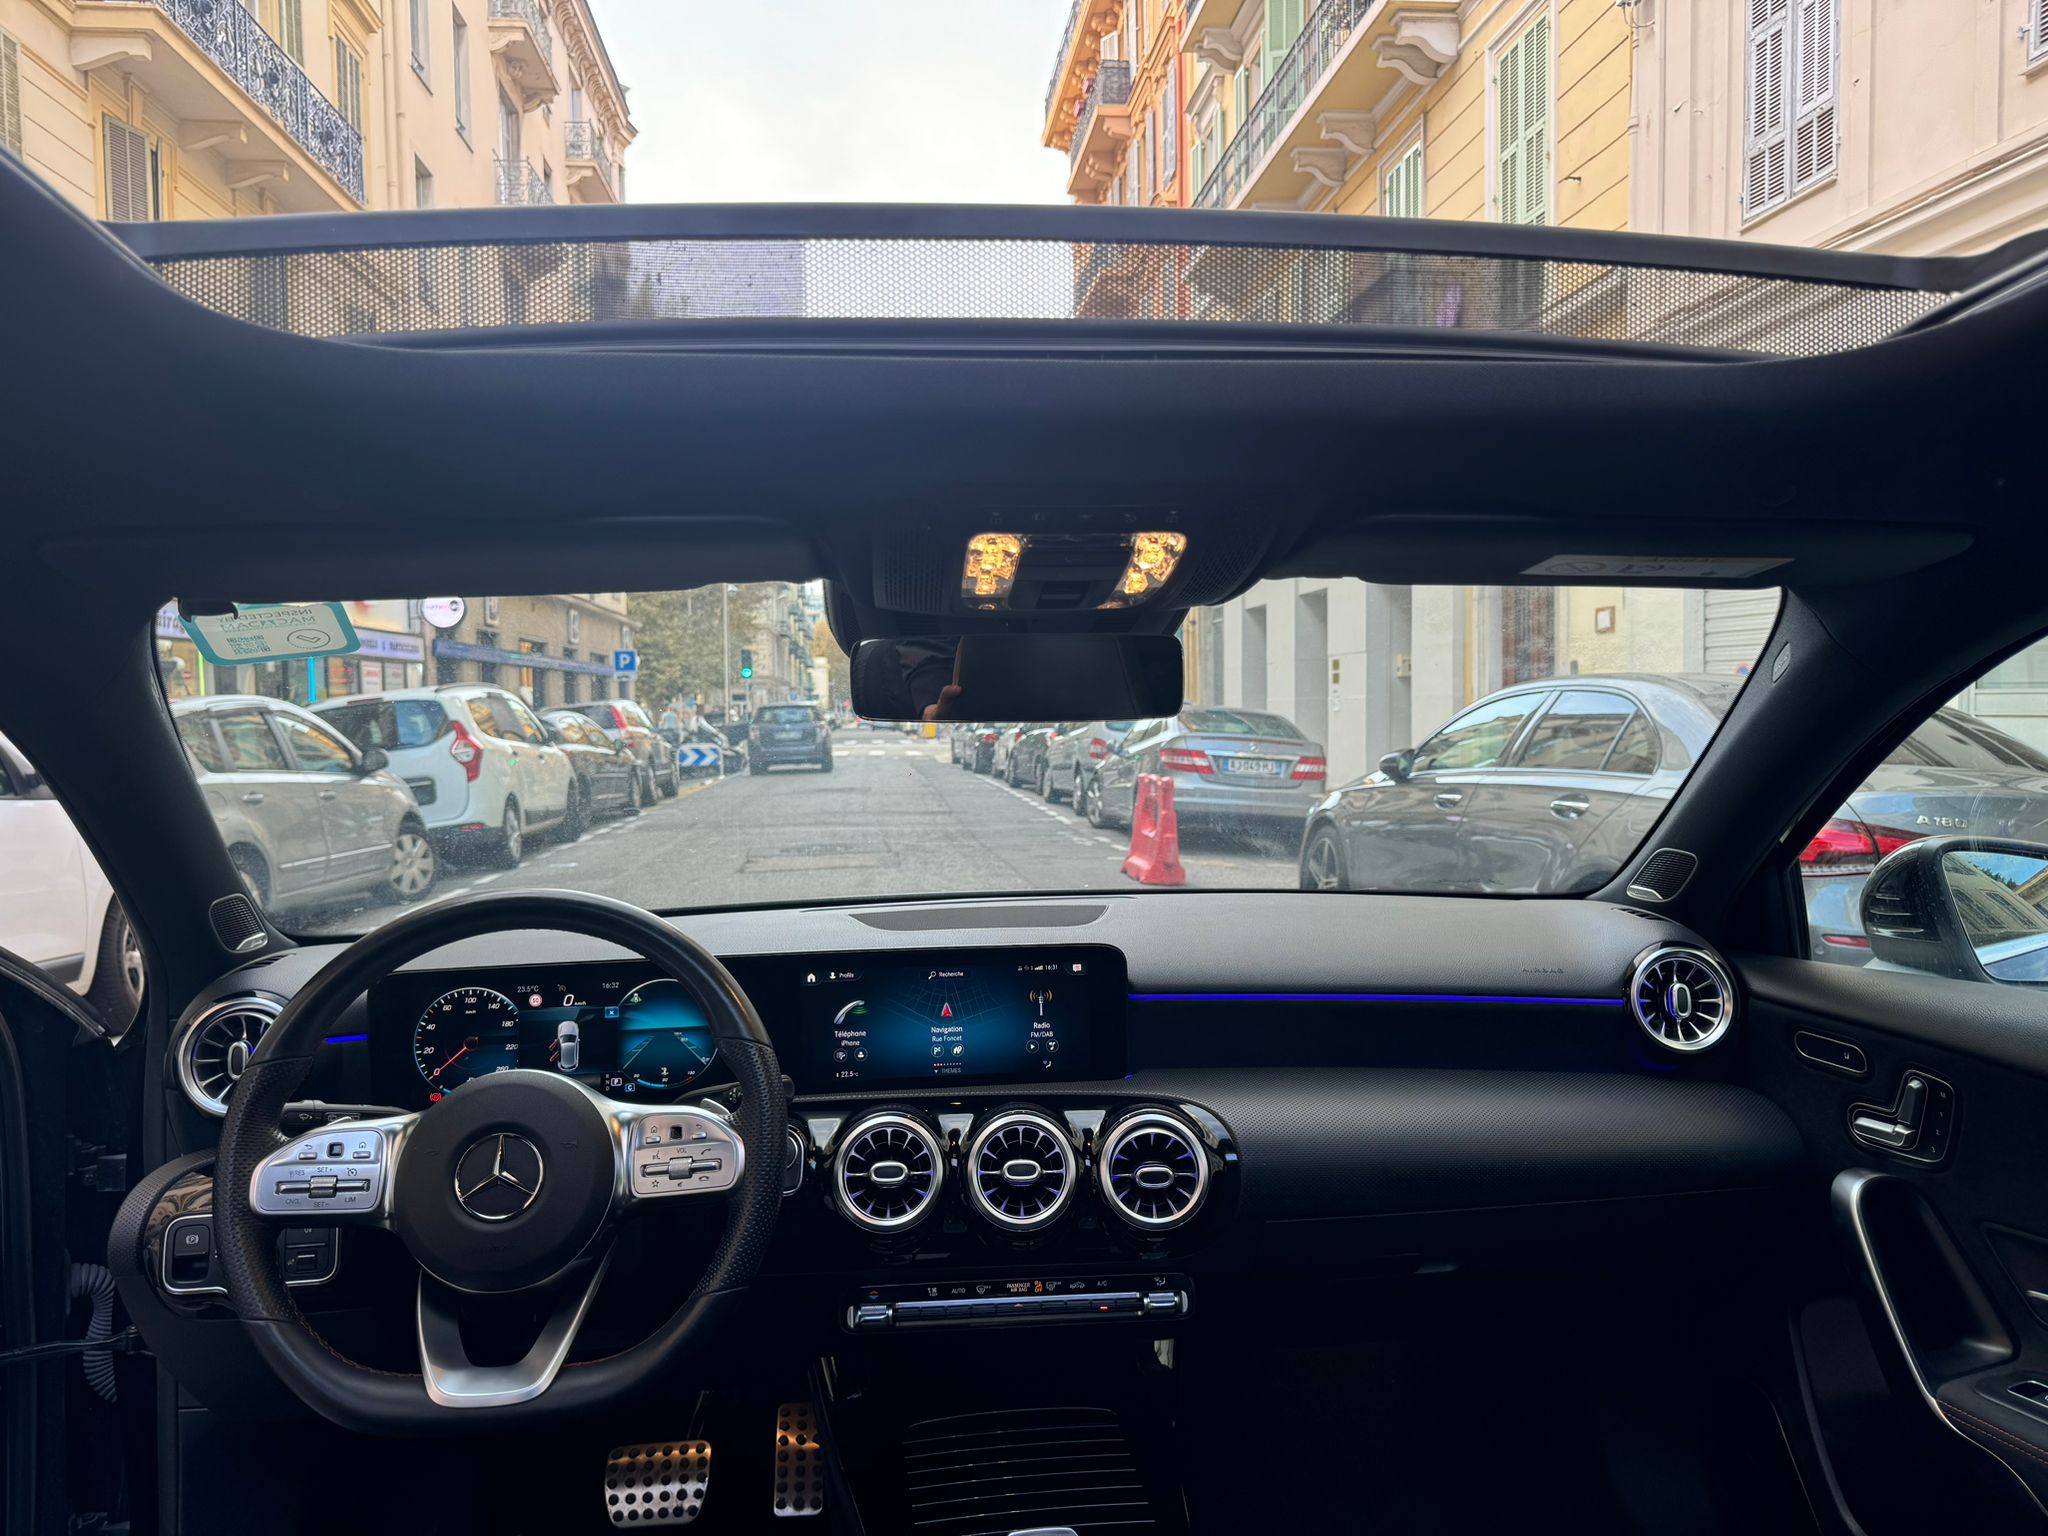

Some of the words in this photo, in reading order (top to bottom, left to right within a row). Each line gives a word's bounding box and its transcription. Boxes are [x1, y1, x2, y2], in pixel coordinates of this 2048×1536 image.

[619, 653, 631, 668] P
[1916, 814, 1930, 826] A
[1933, 816, 1968, 829] 180
[939, 970, 964, 978] Recherche
[602, 981, 620, 989] 16:32
[562, 993, 575, 1007] 0
[487, 1002, 501, 1010] 140
[426, 1023, 436, 1031] 40
[1033, 1021, 1051, 1029] Radio
[930, 1025, 964, 1034] Navigation
[834, 1029, 867, 1039] Téléphone
[1030, 1030, 1054, 1038] FM/DAB
[931, 1035, 943, 1043] Rue
[423, 1046, 435, 1054] 20
[504, 1043, 519, 1051] 220
[951, 1287, 966, 1295] AUTO
